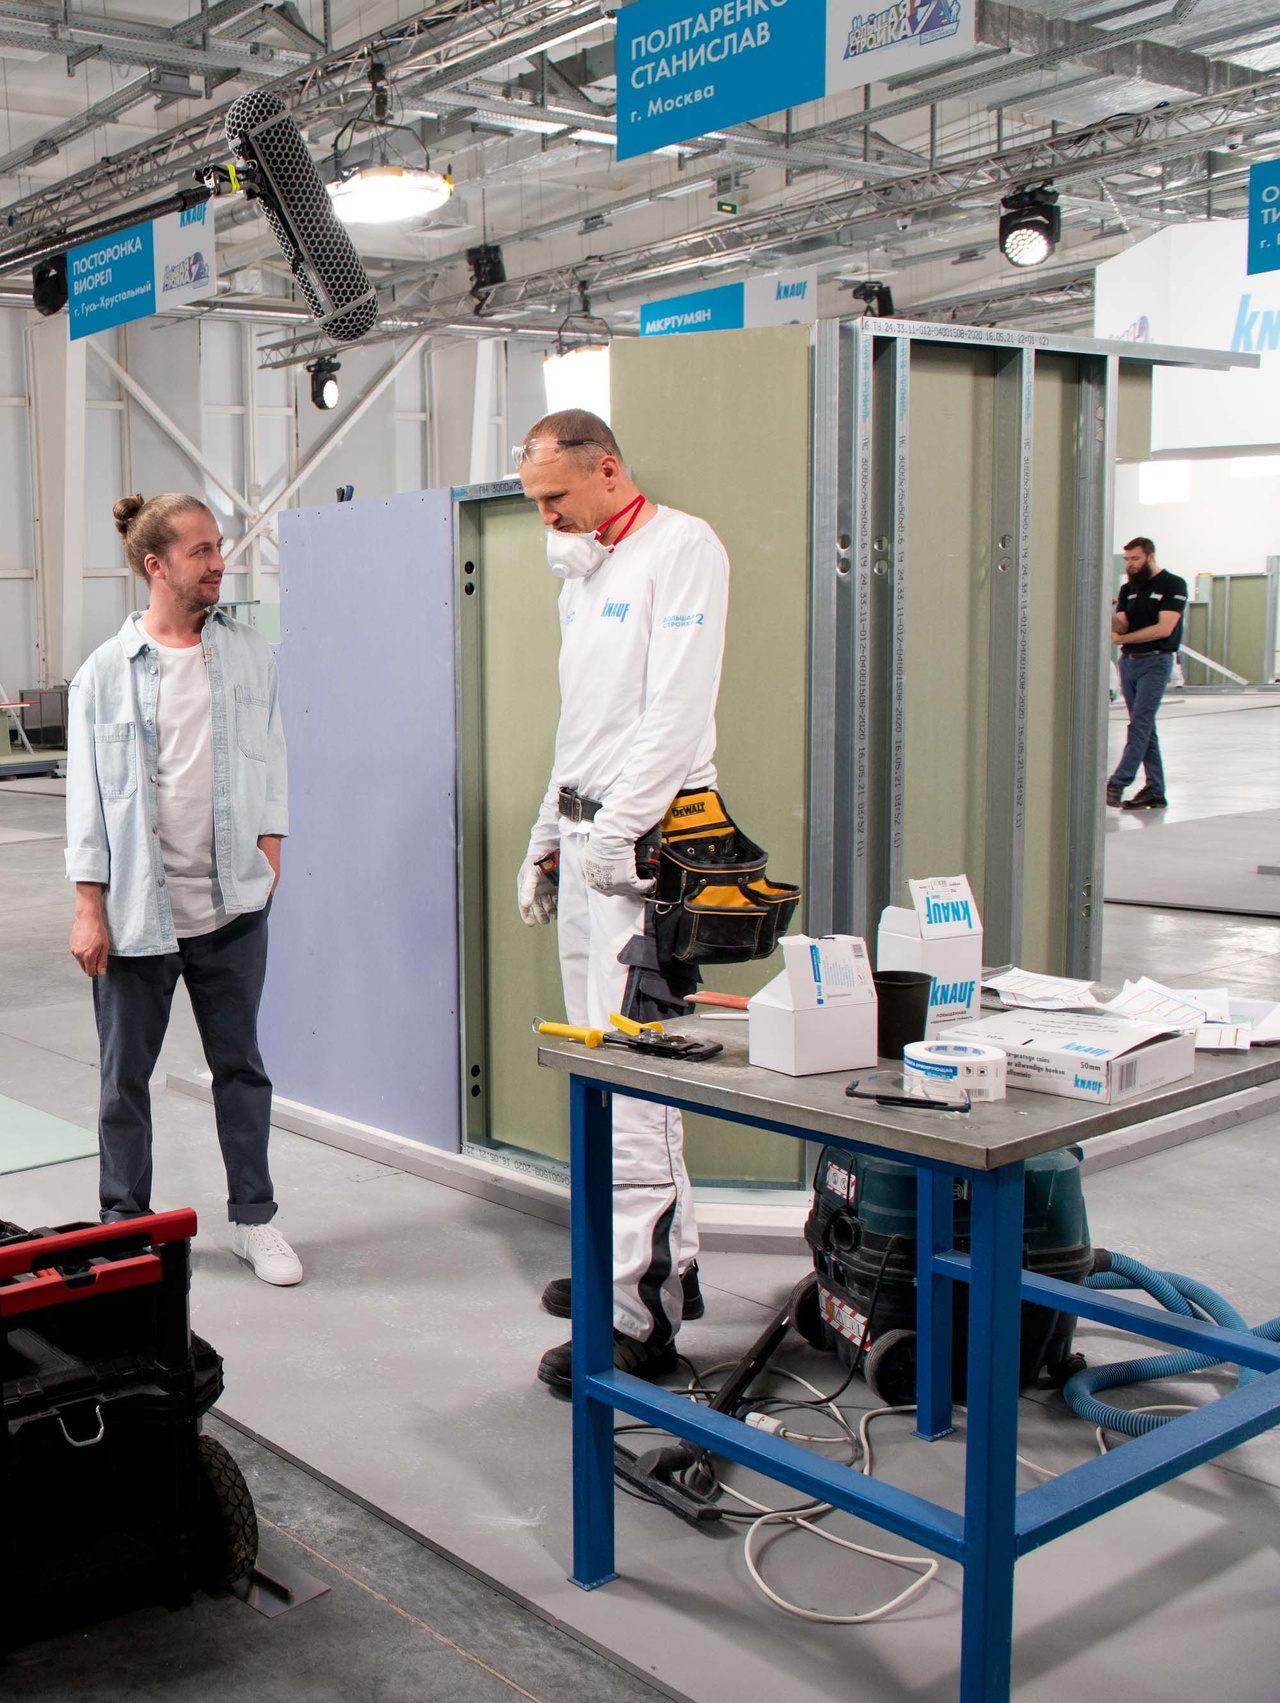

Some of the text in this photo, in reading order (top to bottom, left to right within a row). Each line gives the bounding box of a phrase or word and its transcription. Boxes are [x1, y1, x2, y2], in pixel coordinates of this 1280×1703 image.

[631, 0, 788, 60] ПОЛТАРЕНК
[631, 22, 770, 89] СТАНИСЛАВ
[648, 84, 714, 116] Москва
[73, 236, 142, 276] ПОСТОРОНКА
[74, 268, 112, 296] ВИОРЕЛ
[776, 281, 808, 301] KNAUF
[81, 281, 151, 318] Гусь-Хрустальный
[645, 309, 711, 334] МКРТУМЯН
[696, 613, 704, 625] 2
[926, 896, 972, 929] KNAUF
[930, 976, 975, 1008] KNAUF
[1060, 1041, 1114, 1057] KNAUF
[1080, 1061, 1101, 1072] 50mm
[1074, 1073, 1103, 1095] KNAUF
